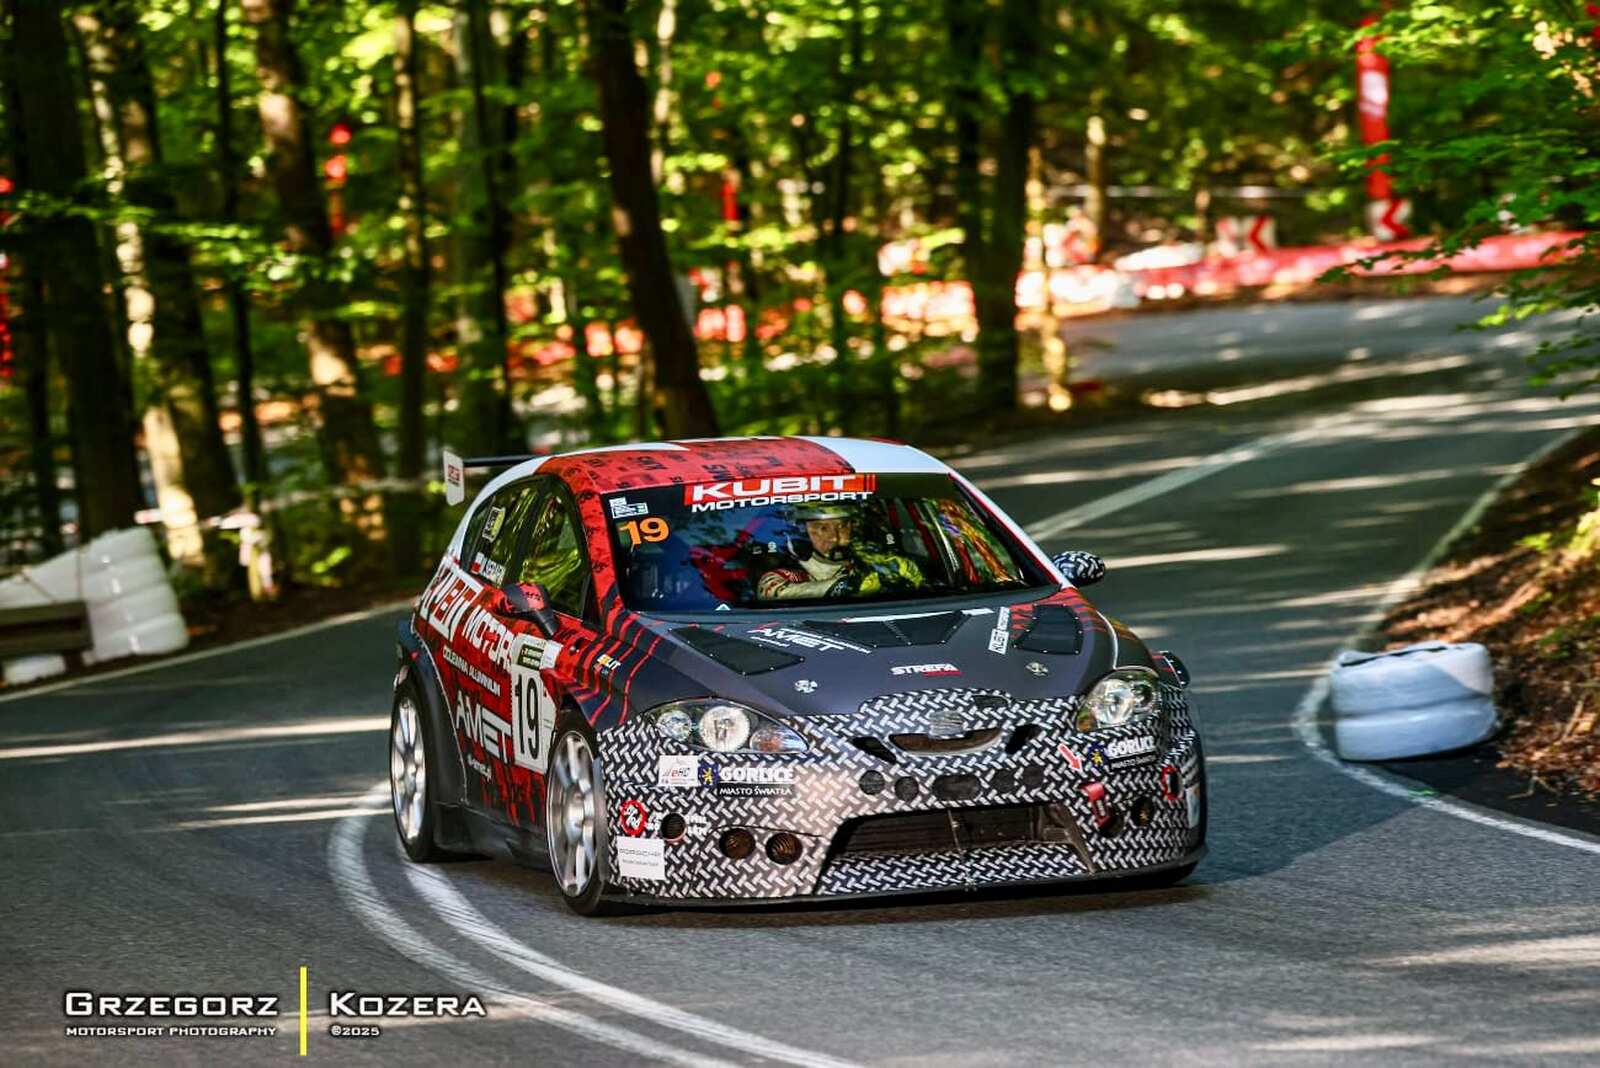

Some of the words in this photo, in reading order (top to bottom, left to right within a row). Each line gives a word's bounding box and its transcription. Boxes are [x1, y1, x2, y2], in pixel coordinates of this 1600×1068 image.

[692, 474, 857, 501] KUBIT
[691, 491, 875, 513] MOTORSPORT
[618, 517, 670, 545] 19
[890, 663, 959, 676] STREFA
[456, 689, 512, 764] AMET
[515, 673, 540, 760] 19
[719, 766, 794, 782] GORLICE
[719, 787, 753, 795] MIASTO
